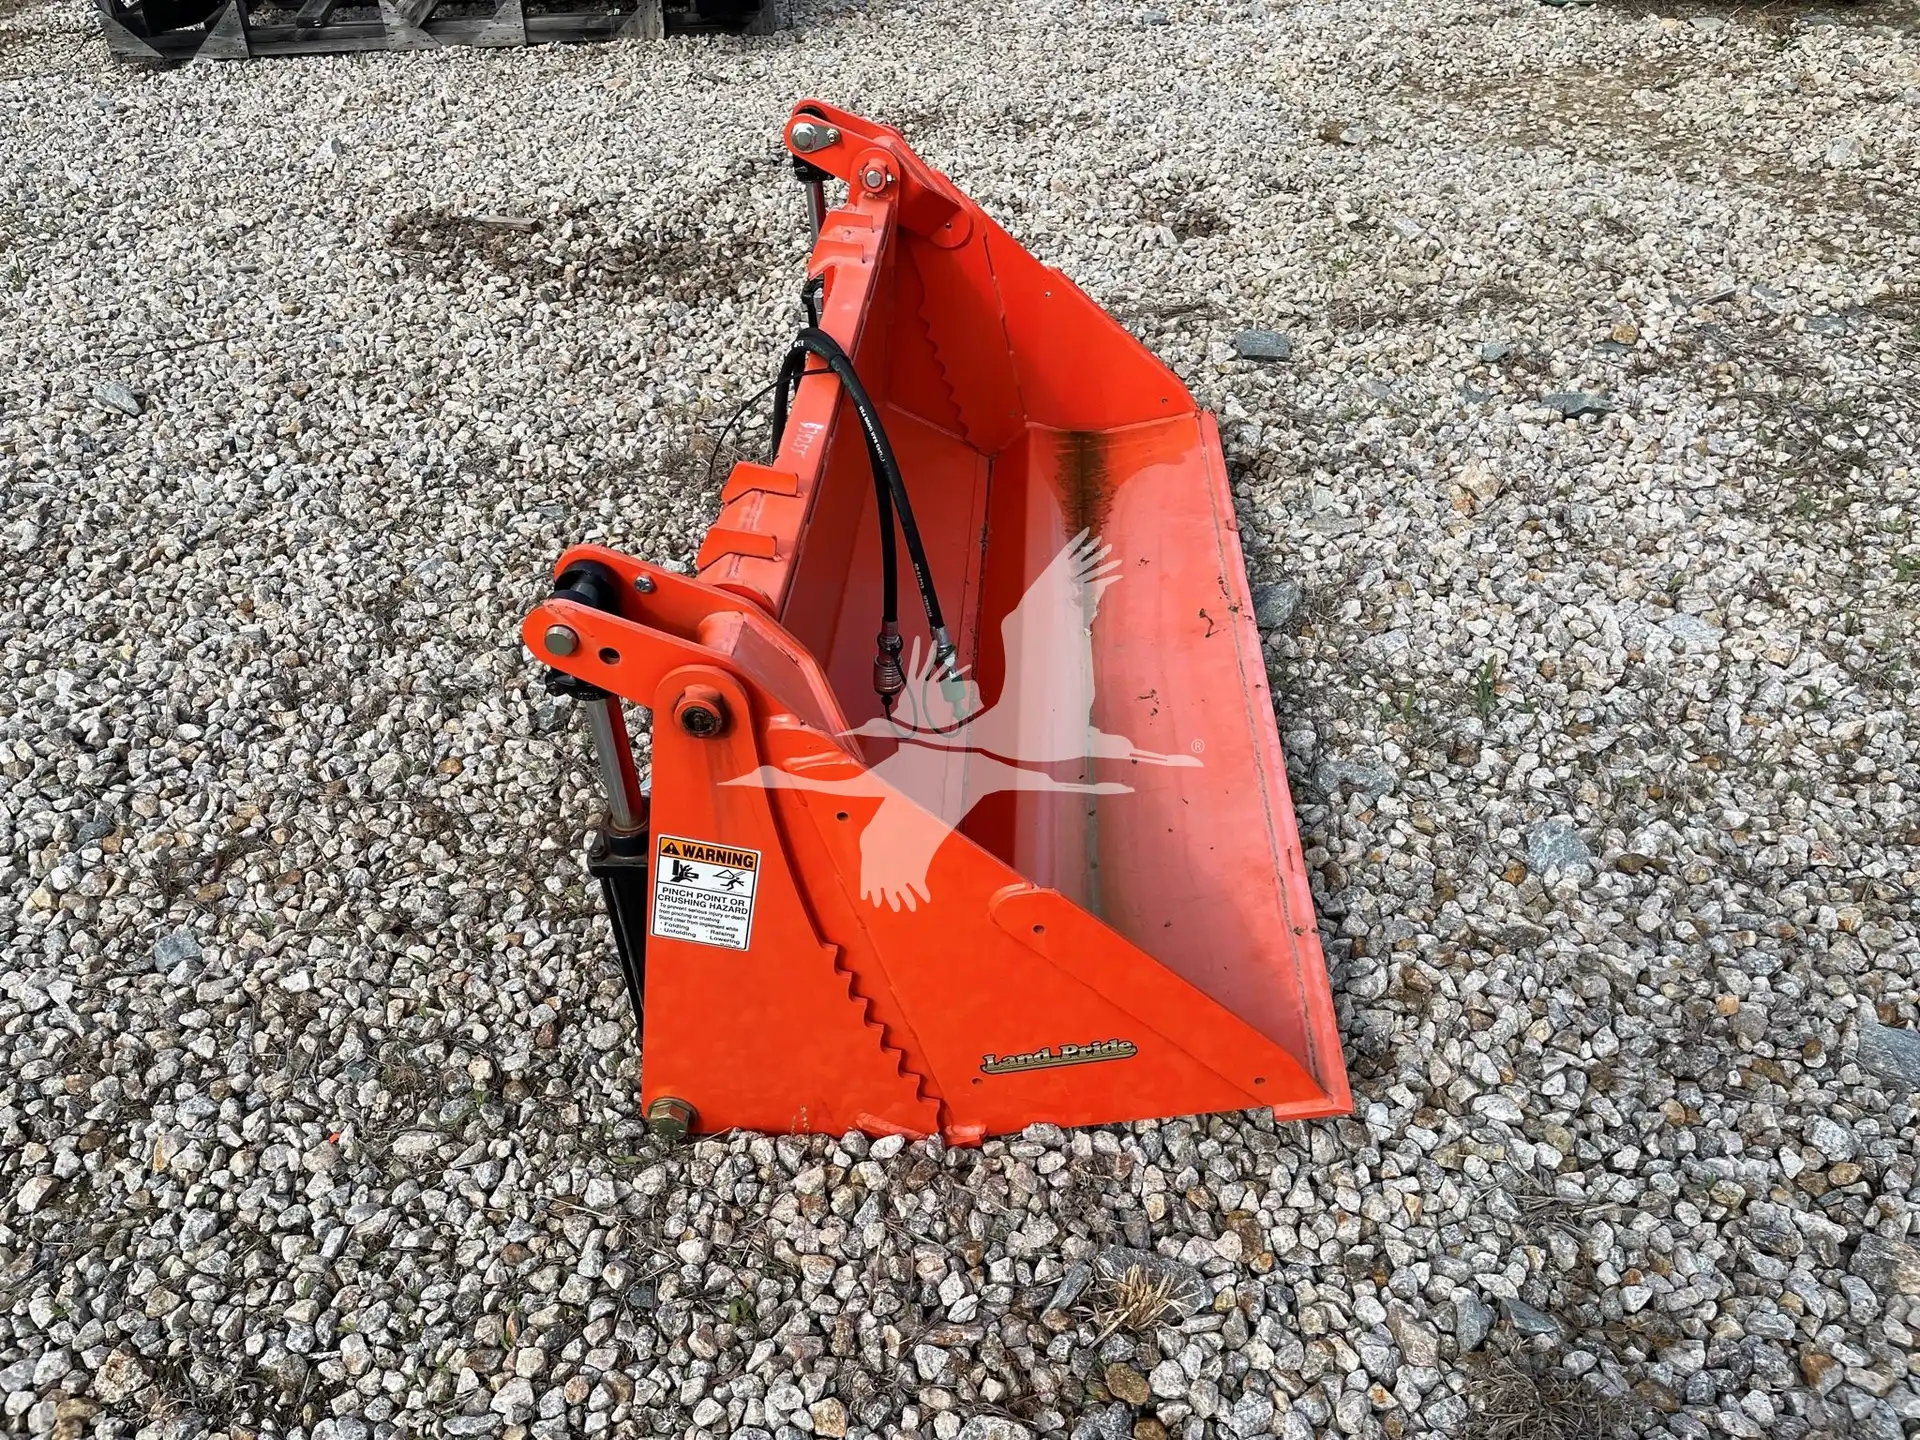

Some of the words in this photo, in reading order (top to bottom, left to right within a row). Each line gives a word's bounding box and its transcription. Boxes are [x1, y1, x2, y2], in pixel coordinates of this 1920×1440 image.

[682, 843, 754, 868] WARNING
[662, 886, 693, 898] PINCH
[696, 892, 727, 904] POINT
[730, 898, 745, 907] OR
[657, 893, 707, 908] CRUSHING
[709, 902, 748, 915] HAZARD
[688, 907, 708, 915] serious
[671, 911, 692, 919] pinching
[699, 915, 720, 924] crushing
[664, 921, 690, 931] Folding
[699, 921, 725, 930] implement
[663, 928, 697, 938] Unfolding
[710, 929, 735, 939] Raising
[709, 936, 741, 946] Lowering
[983, 1047, 1050, 1071] Land
[1059, 1039, 1134, 1061] Pride
